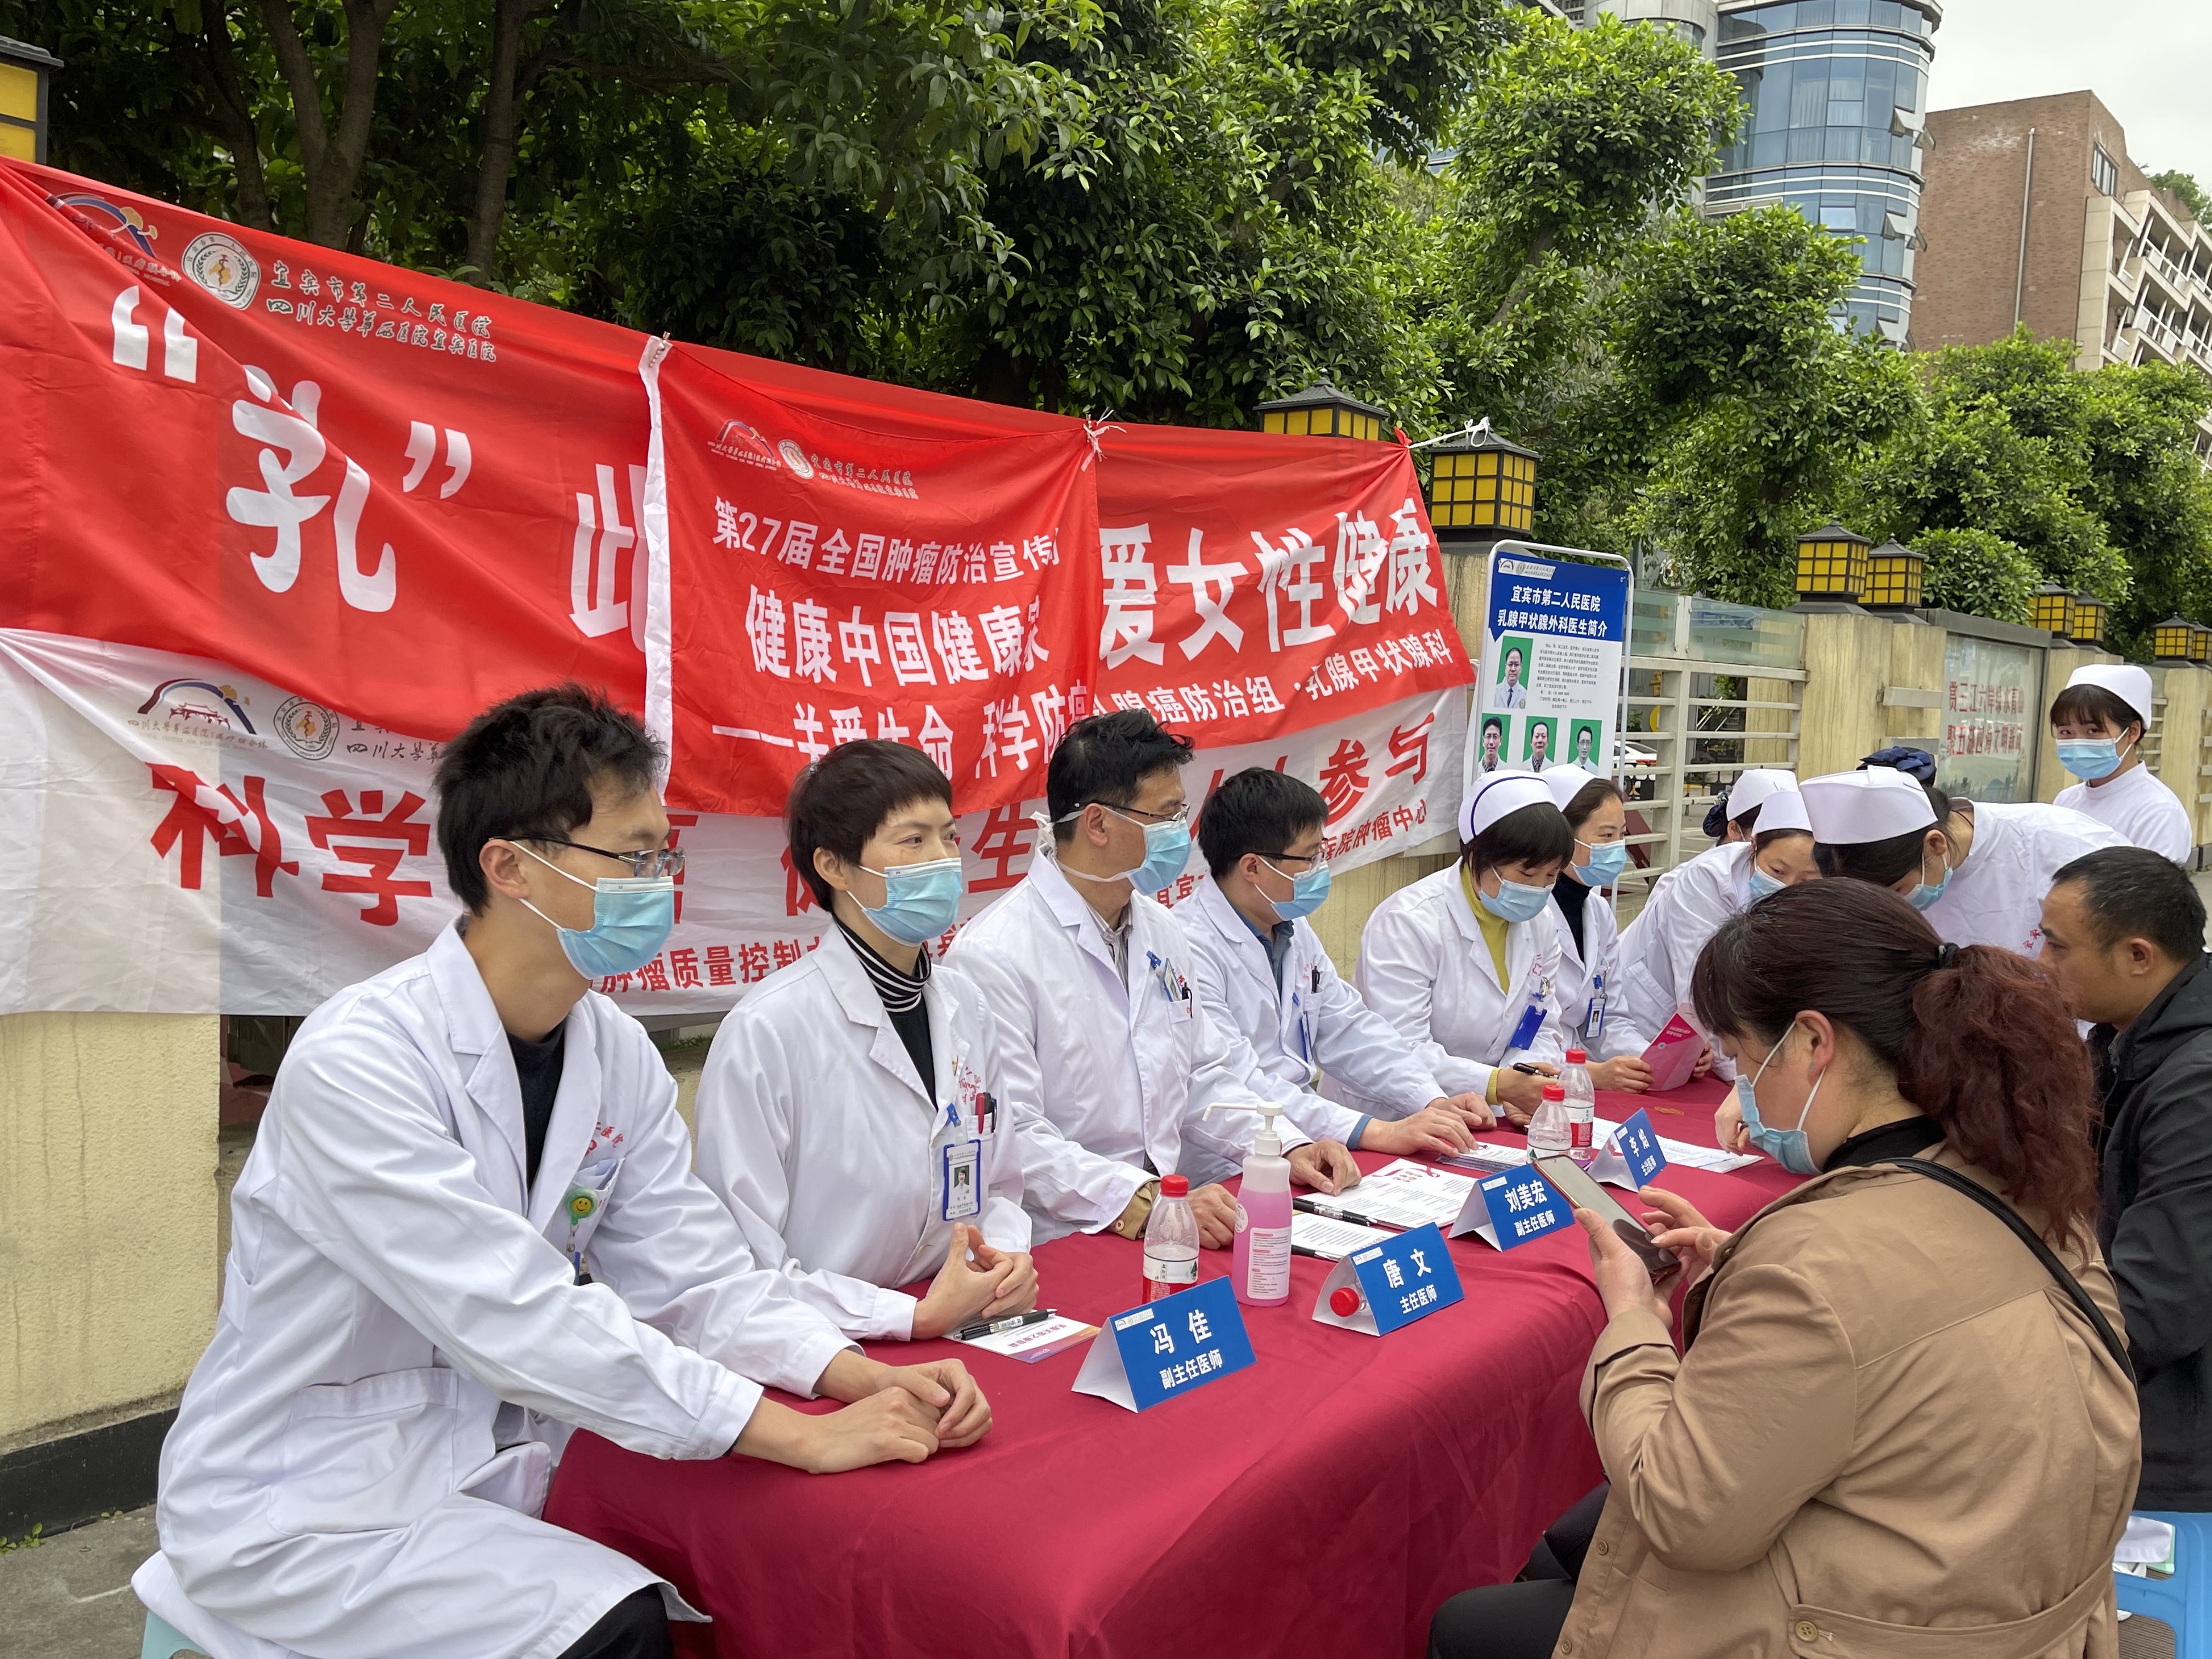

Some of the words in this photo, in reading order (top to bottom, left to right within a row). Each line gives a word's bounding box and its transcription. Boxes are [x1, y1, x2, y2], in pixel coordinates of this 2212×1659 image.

[1099, 498, 1438, 671] 爱女性健康
[1511, 585, 1601, 612] 宜宾市第二人民医院
[1497, 609, 1607, 637] 乳腺甲状腺外科医生简介
[1505, 1180, 1548, 1213] 刘美宏
[1514, 1210, 1555, 1237] 副主任医师
[1400, 1284, 1437, 1314] 主任医师
[1159, 1348, 1223, 1390] 副主任医师
